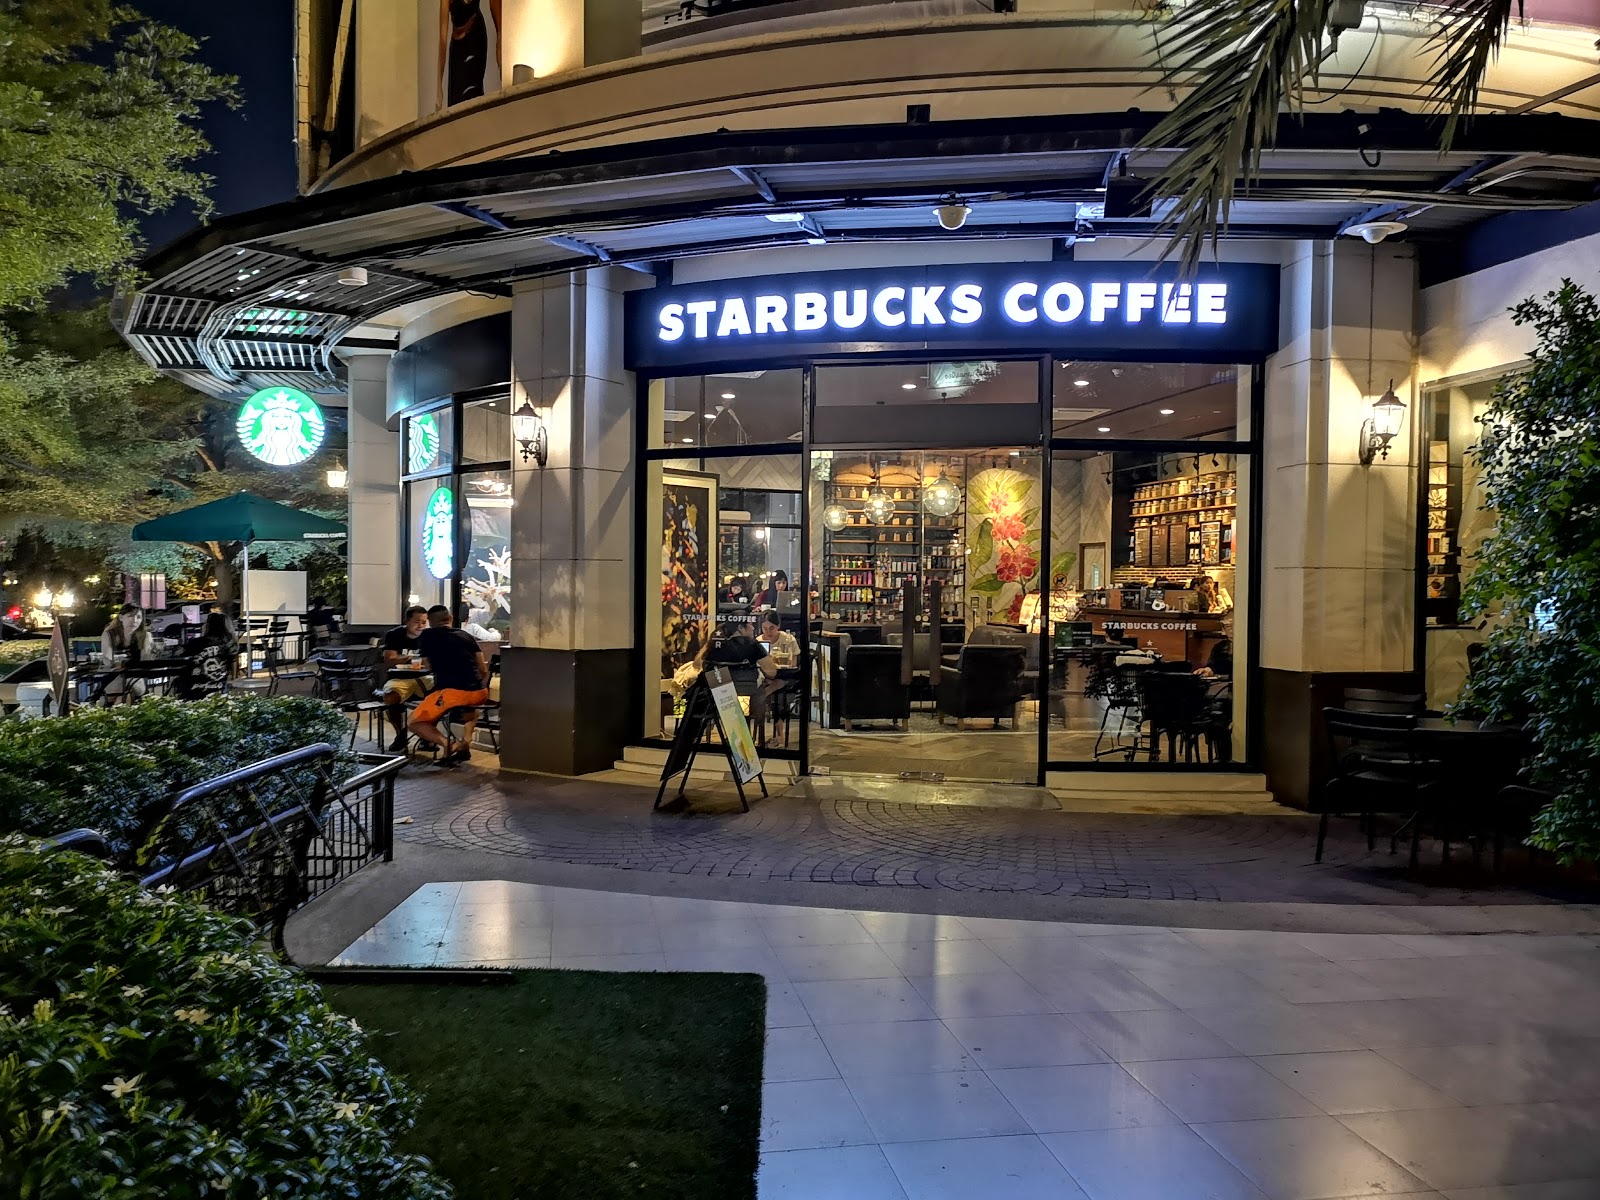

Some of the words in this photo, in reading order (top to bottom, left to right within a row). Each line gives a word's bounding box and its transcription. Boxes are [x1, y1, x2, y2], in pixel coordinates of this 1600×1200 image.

[658, 284, 983, 341] STARBUCKS
[1003, 281, 1228, 324] COFFEE
[728, 615, 757, 623] COFFEE
[1101, 622, 1159, 630] STARBUCKS
[1161, 623, 1197, 631] COFFEE
